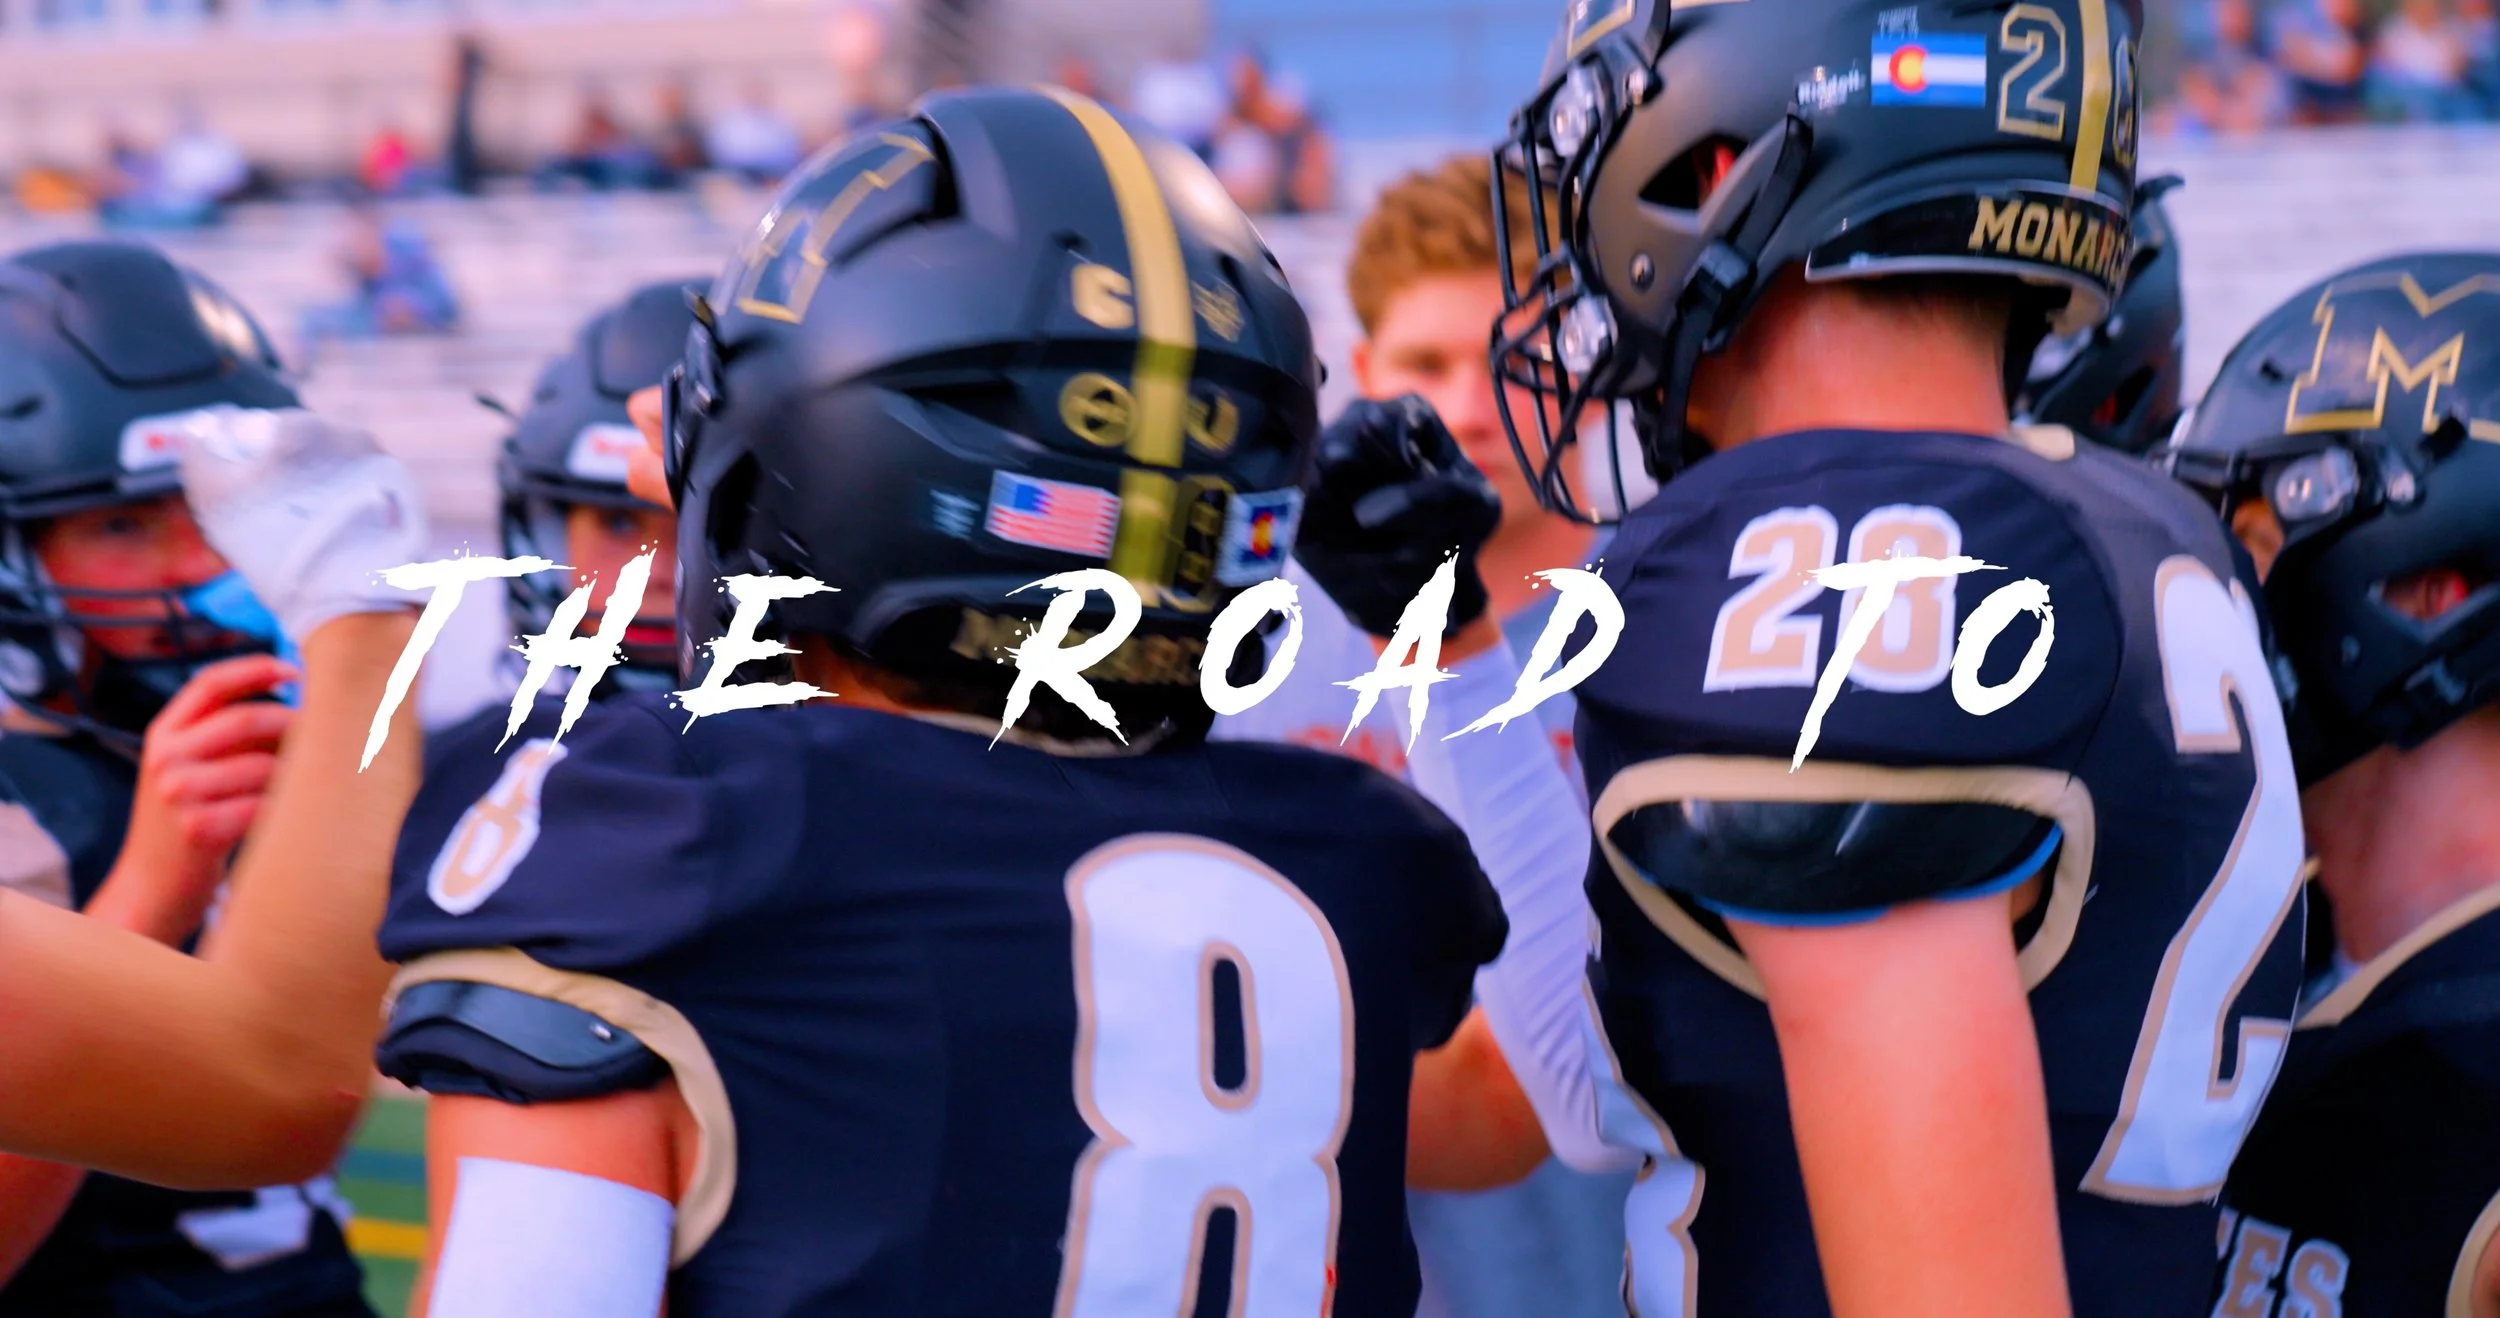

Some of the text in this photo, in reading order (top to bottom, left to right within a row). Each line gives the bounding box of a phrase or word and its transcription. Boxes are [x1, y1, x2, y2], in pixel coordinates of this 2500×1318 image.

[1998, 2, 2067, 141] 2
[2283, 270, 2500, 440] M
[1702, 503, 1963, 693] 28
[426, 737, 570, 917] 8
[1055, 831, 1356, 1318] 8
[2208, 1205, 2351, 1318] ES
